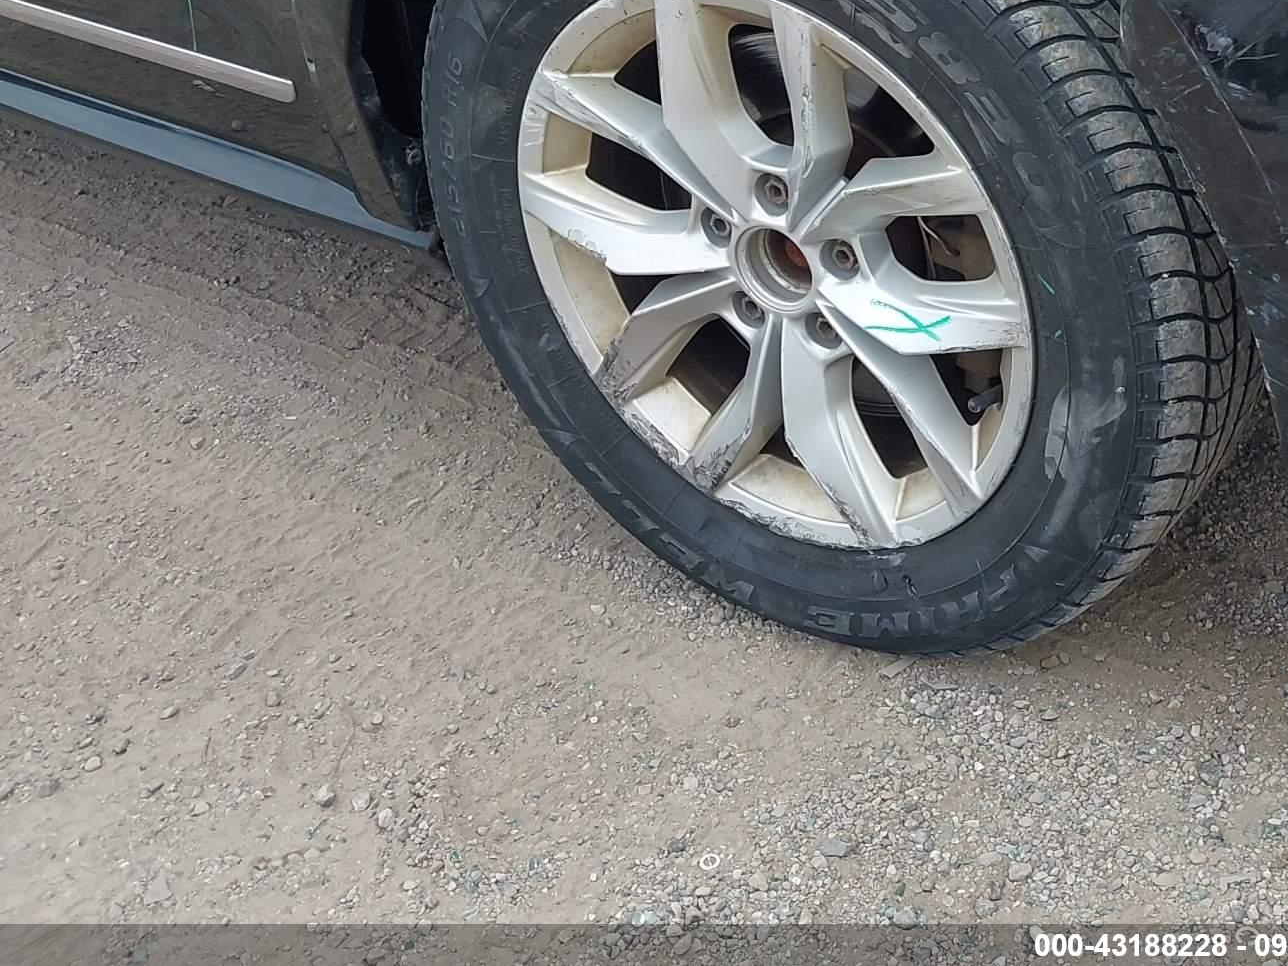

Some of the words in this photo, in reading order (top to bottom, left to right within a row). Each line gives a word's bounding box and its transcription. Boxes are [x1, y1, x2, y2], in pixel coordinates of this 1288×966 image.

[447, 51, 465, 107] R16
[438, 117, 467, 239] 215/60
[584, 461, 755, 604] WELL
[803, 562, 1020, 638] PRIME
